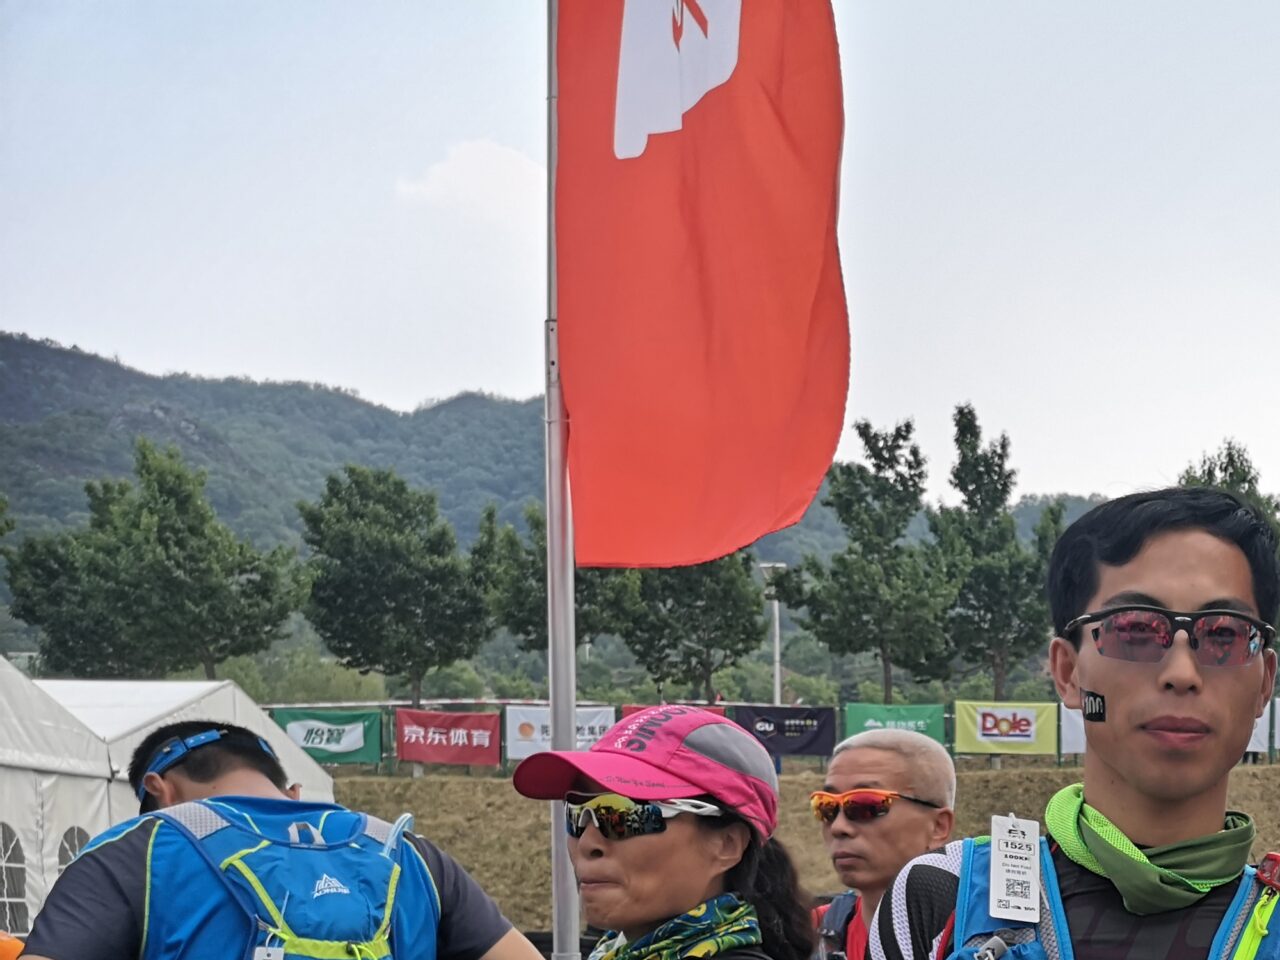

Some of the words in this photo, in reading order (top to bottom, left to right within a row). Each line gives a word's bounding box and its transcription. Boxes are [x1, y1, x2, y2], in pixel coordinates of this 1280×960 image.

[755, 722, 775, 732] GU
[981, 711, 1032, 736] Dole
[403, 724, 492, 748] 京东体育
